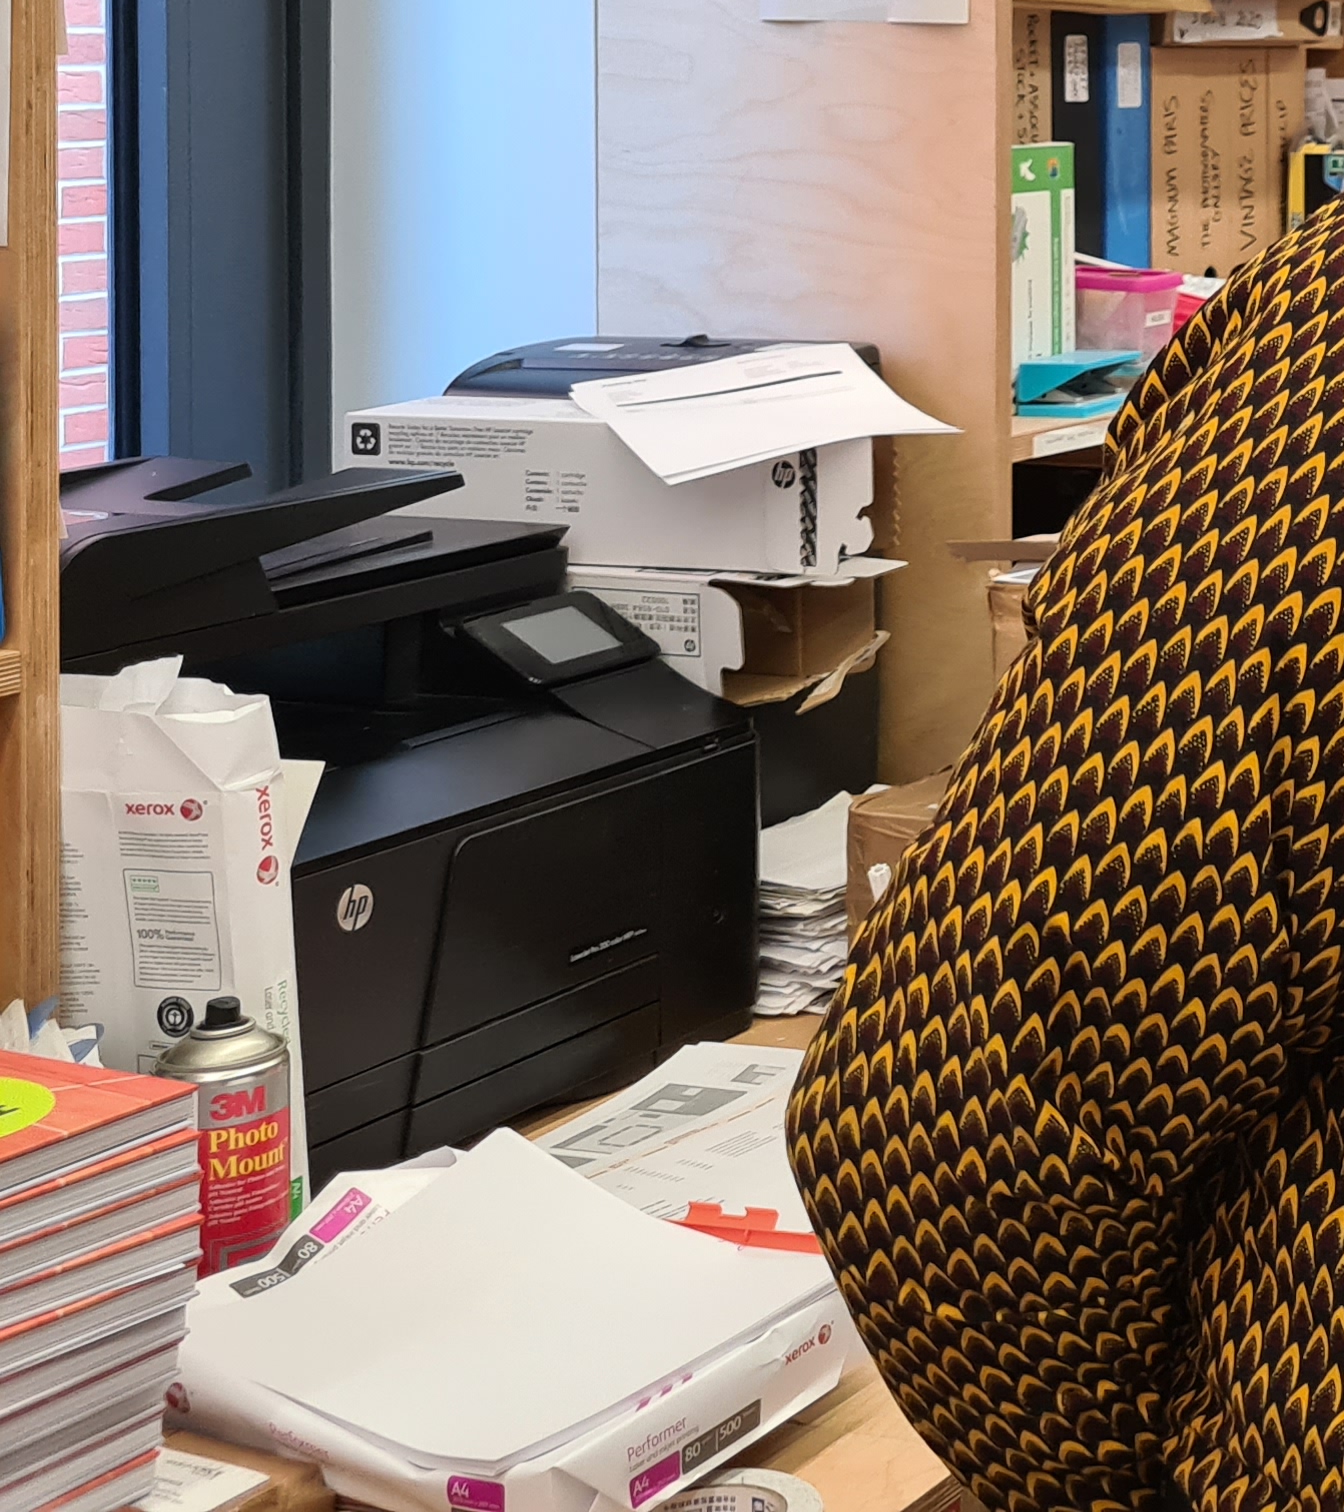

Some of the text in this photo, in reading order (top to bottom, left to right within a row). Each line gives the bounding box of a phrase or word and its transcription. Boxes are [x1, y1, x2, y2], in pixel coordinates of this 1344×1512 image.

[1238, 58, 1258, 252] VINTAGE PRICES
[1163, 95, 1180, 257] MAGNUM PARIS
[772, 460, 795, 488] hp
[125, 803, 175, 815] xerox
[256, 785, 273, 851] xerox
[340, 883, 371, 932] hp
[136, 929, 164, 940] 100%
[210, 1085, 266, 1121] 3M
[207, 1120, 279, 1154] Photo
[208, 1143, 286, 1181] Mount
[343, 1194, 364, 1214] A4
[298, 1241, 318, 1259] 80
[257, 1272, 286, 1289] 500
[785, 1336, 815, 1365] xerox
[627, 1417, 687, 1462] Performer
[684, 1415, 741, 1462] 80 500
[451, 1481, 470, 1498] A4
[632, 1475, 650, 1497] A4
